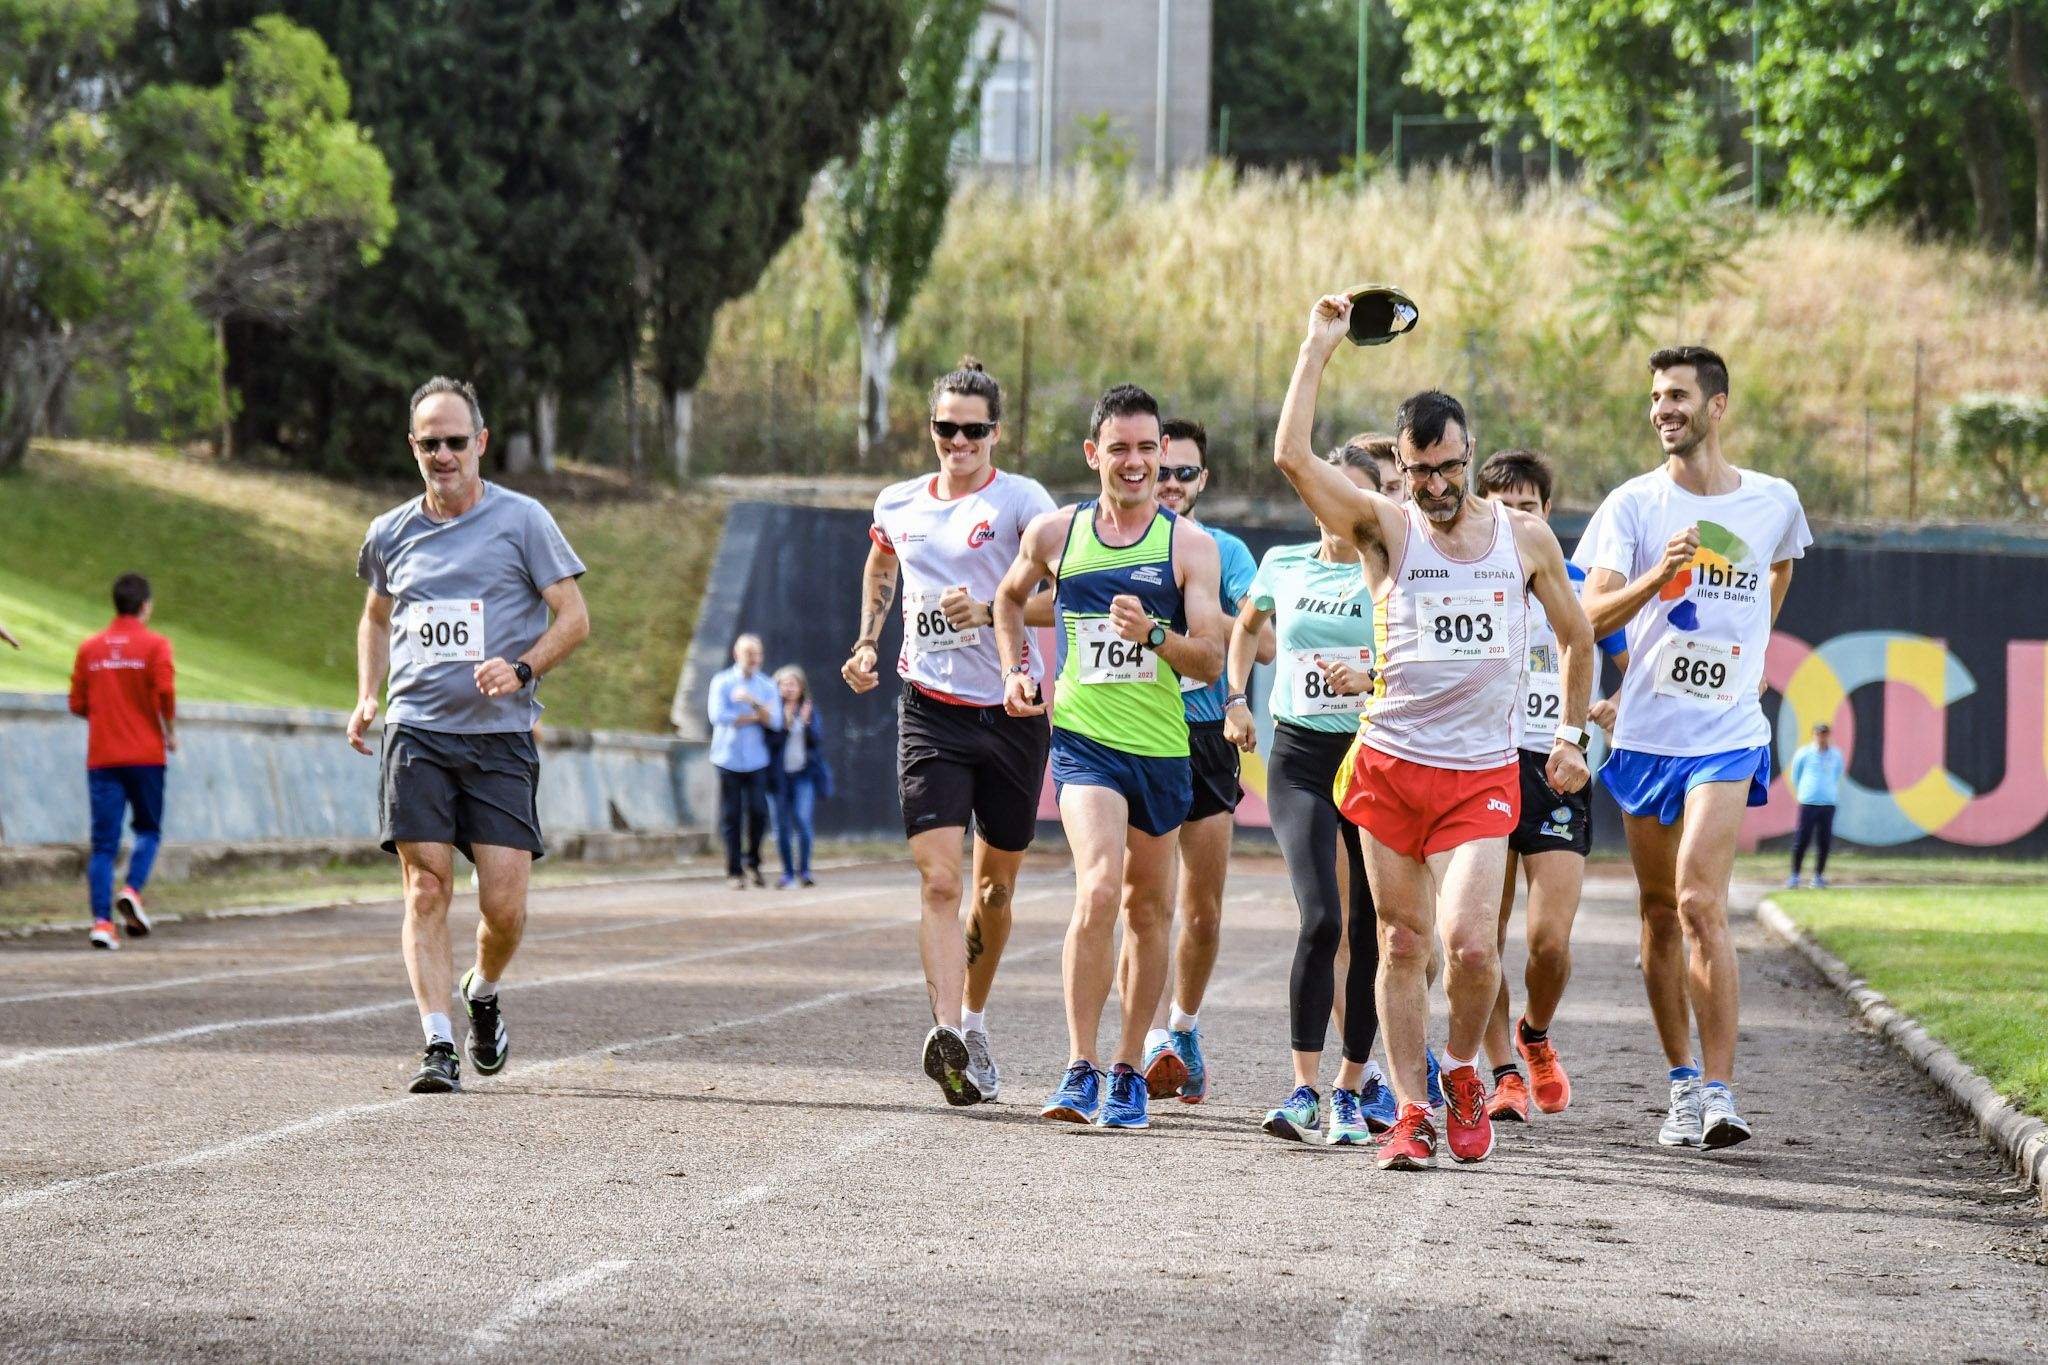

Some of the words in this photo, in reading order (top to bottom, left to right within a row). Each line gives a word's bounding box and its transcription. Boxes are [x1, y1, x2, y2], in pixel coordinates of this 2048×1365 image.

[1474, 570, 1515, 579] ESPAÑA
[1698, 563, 1758, 591] Ibiza
[1697, 589, 1719, 599] Illes
[1723, 591, 1756, 603] Balears
[420, 621, 469, 647] 906
[1434, 613, 1493, 643] 803
[1090, 641, 1144, 668] 764
[1671, 656, 1727, 689] 869
